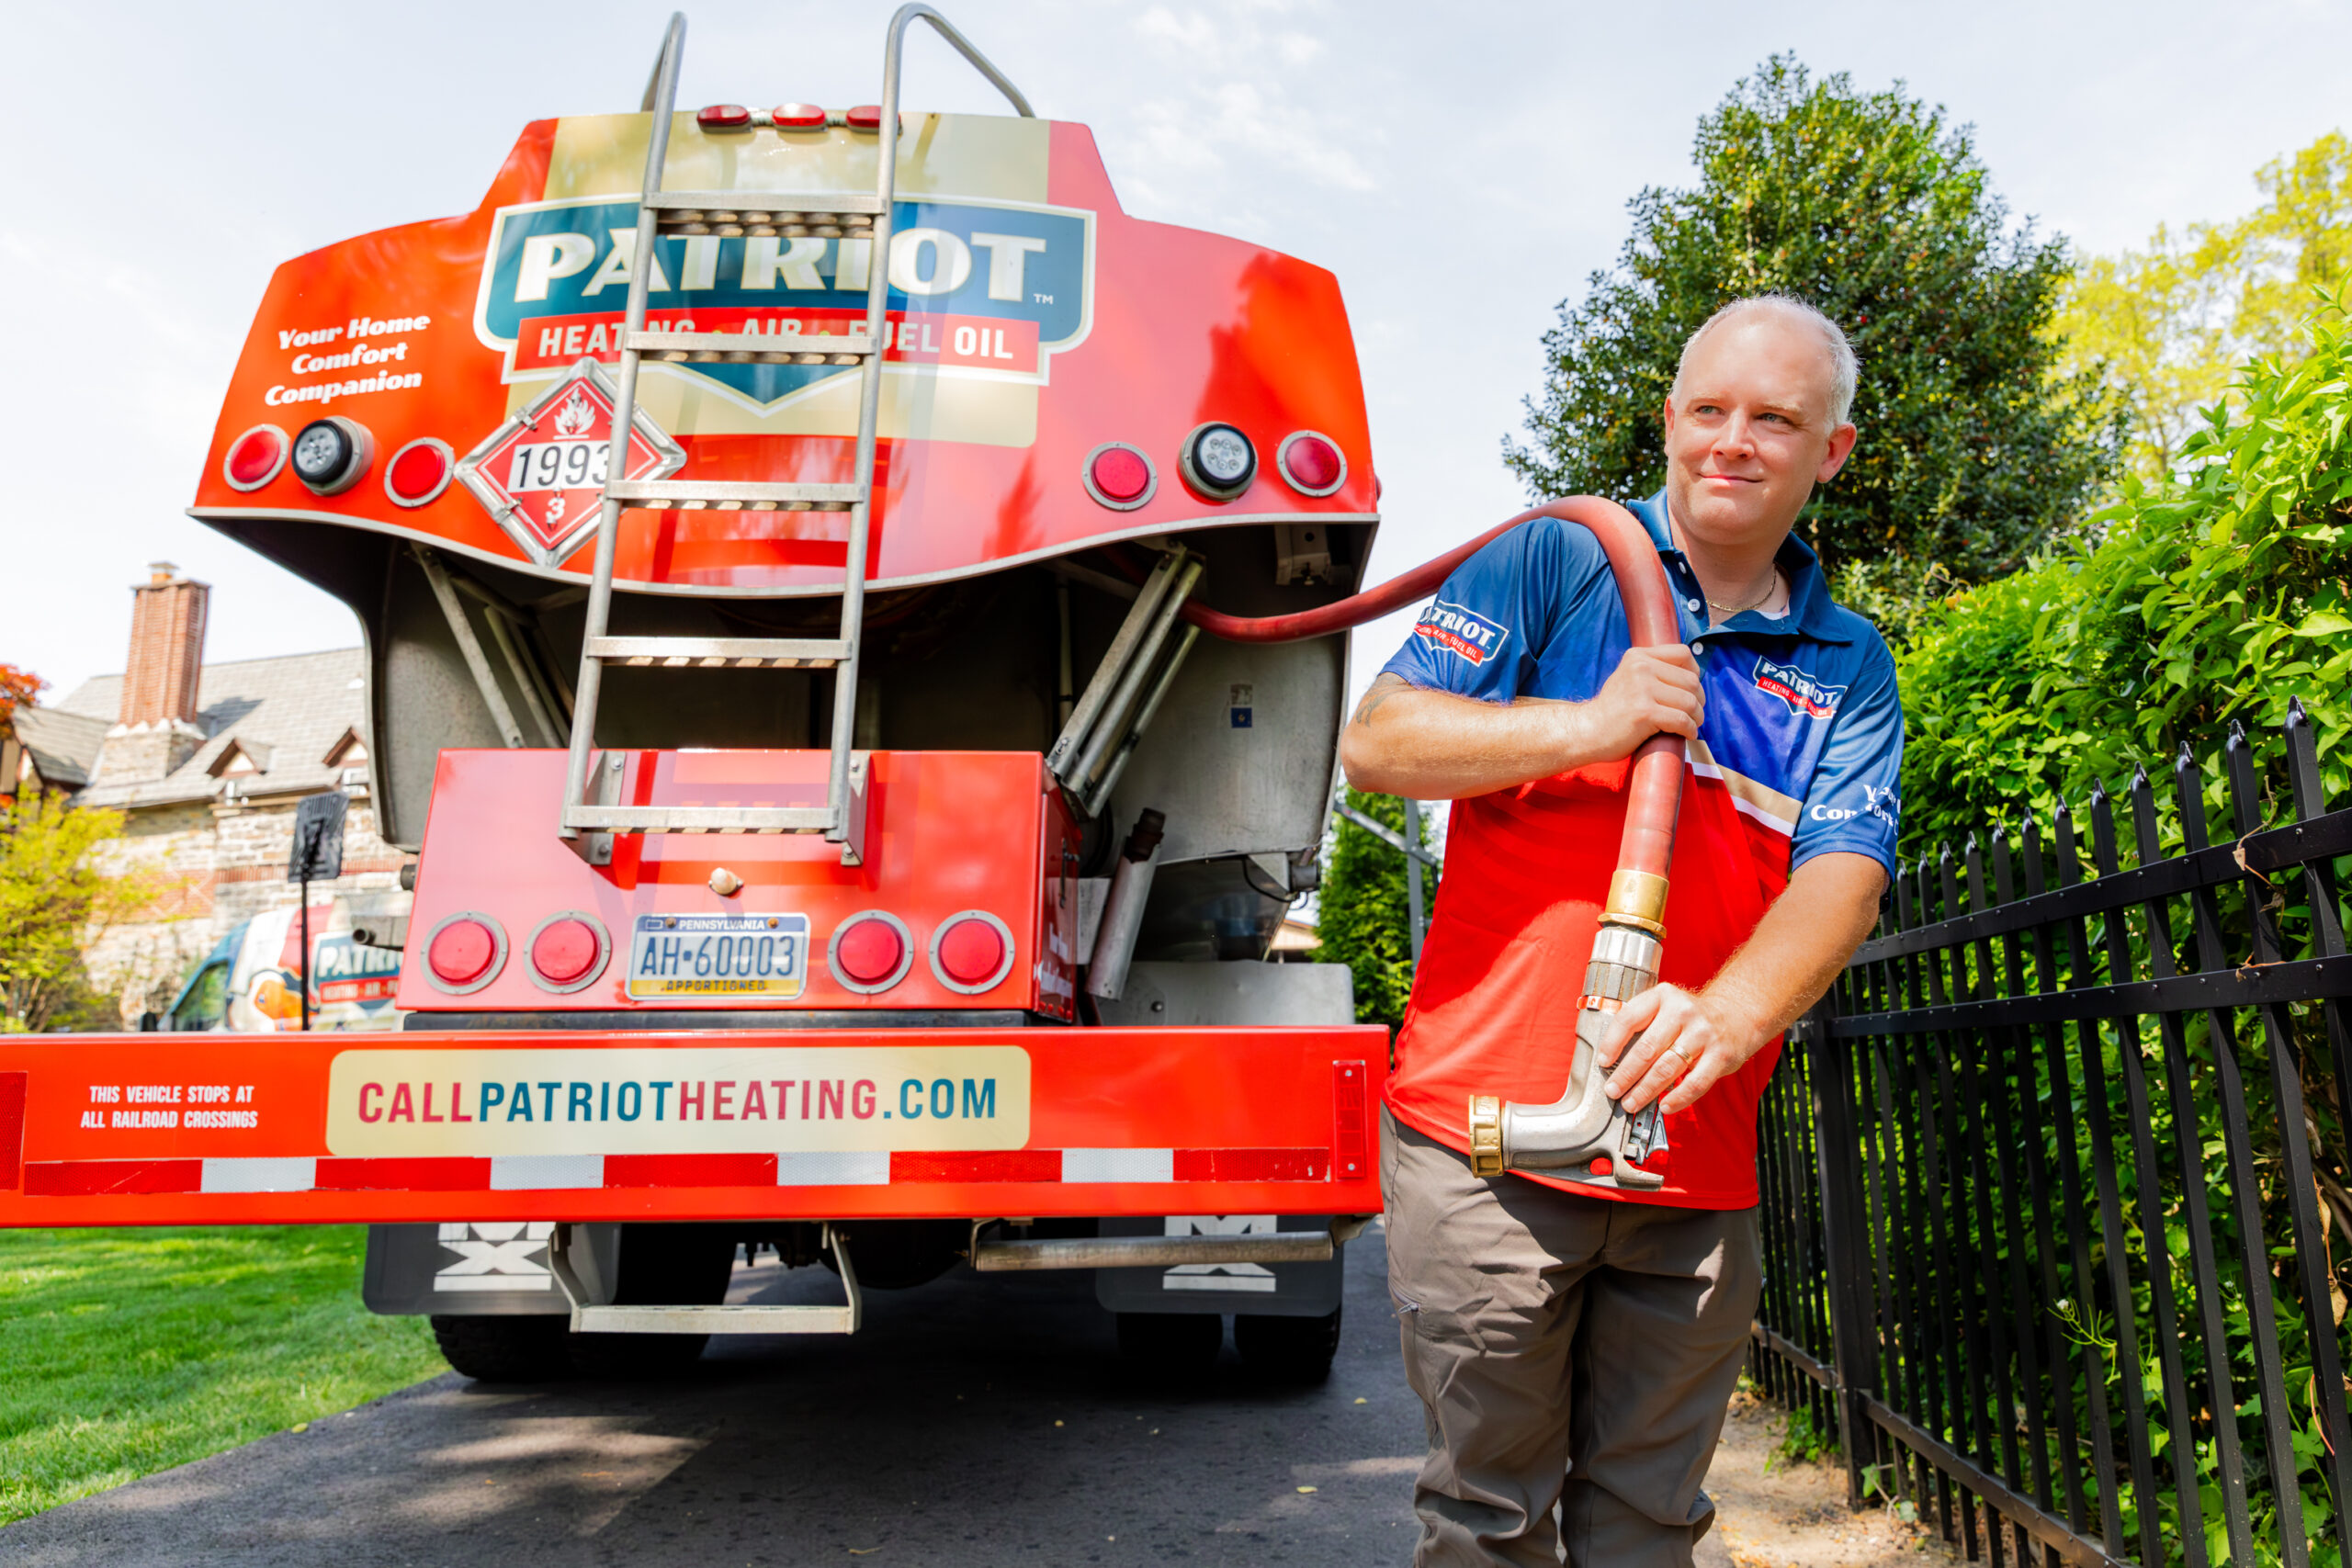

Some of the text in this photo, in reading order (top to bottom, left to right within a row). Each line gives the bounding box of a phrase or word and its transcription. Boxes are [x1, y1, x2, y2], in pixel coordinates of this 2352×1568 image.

[514, 227, 1054, 305] PATRIOT TM
[278, 315, 431, 349] Your Home
[538, 320, 695, 357] HEAT
[954, 326, 1013, 359] OIL
[291, 343, 408, 374] Comfort
[265, 369, 423, 406] Companion
[546, 497, 566, 522] 3
[1419, 606, 1496, 648] TRIOT
[1449, 637, 1466, 652] FUEL
[1465, 646, 1478, 659] OIL
[1761, 661, 1838, 706] PATRIOT
[1762, 680, 1791, 697] HEATING
[678, 919, 765, 931] PENNSYLVANIA
[666, 979, 766, 991] APPORTIONED
[89, 1085, 254, 1103] THIS VEHICLE STOPS AT
[357, 1078, 997, 1124] CALLPATRIOTHEATING.COM
[80, 1110, 258, 1129] ALL RAILROAD CROSSINGS
